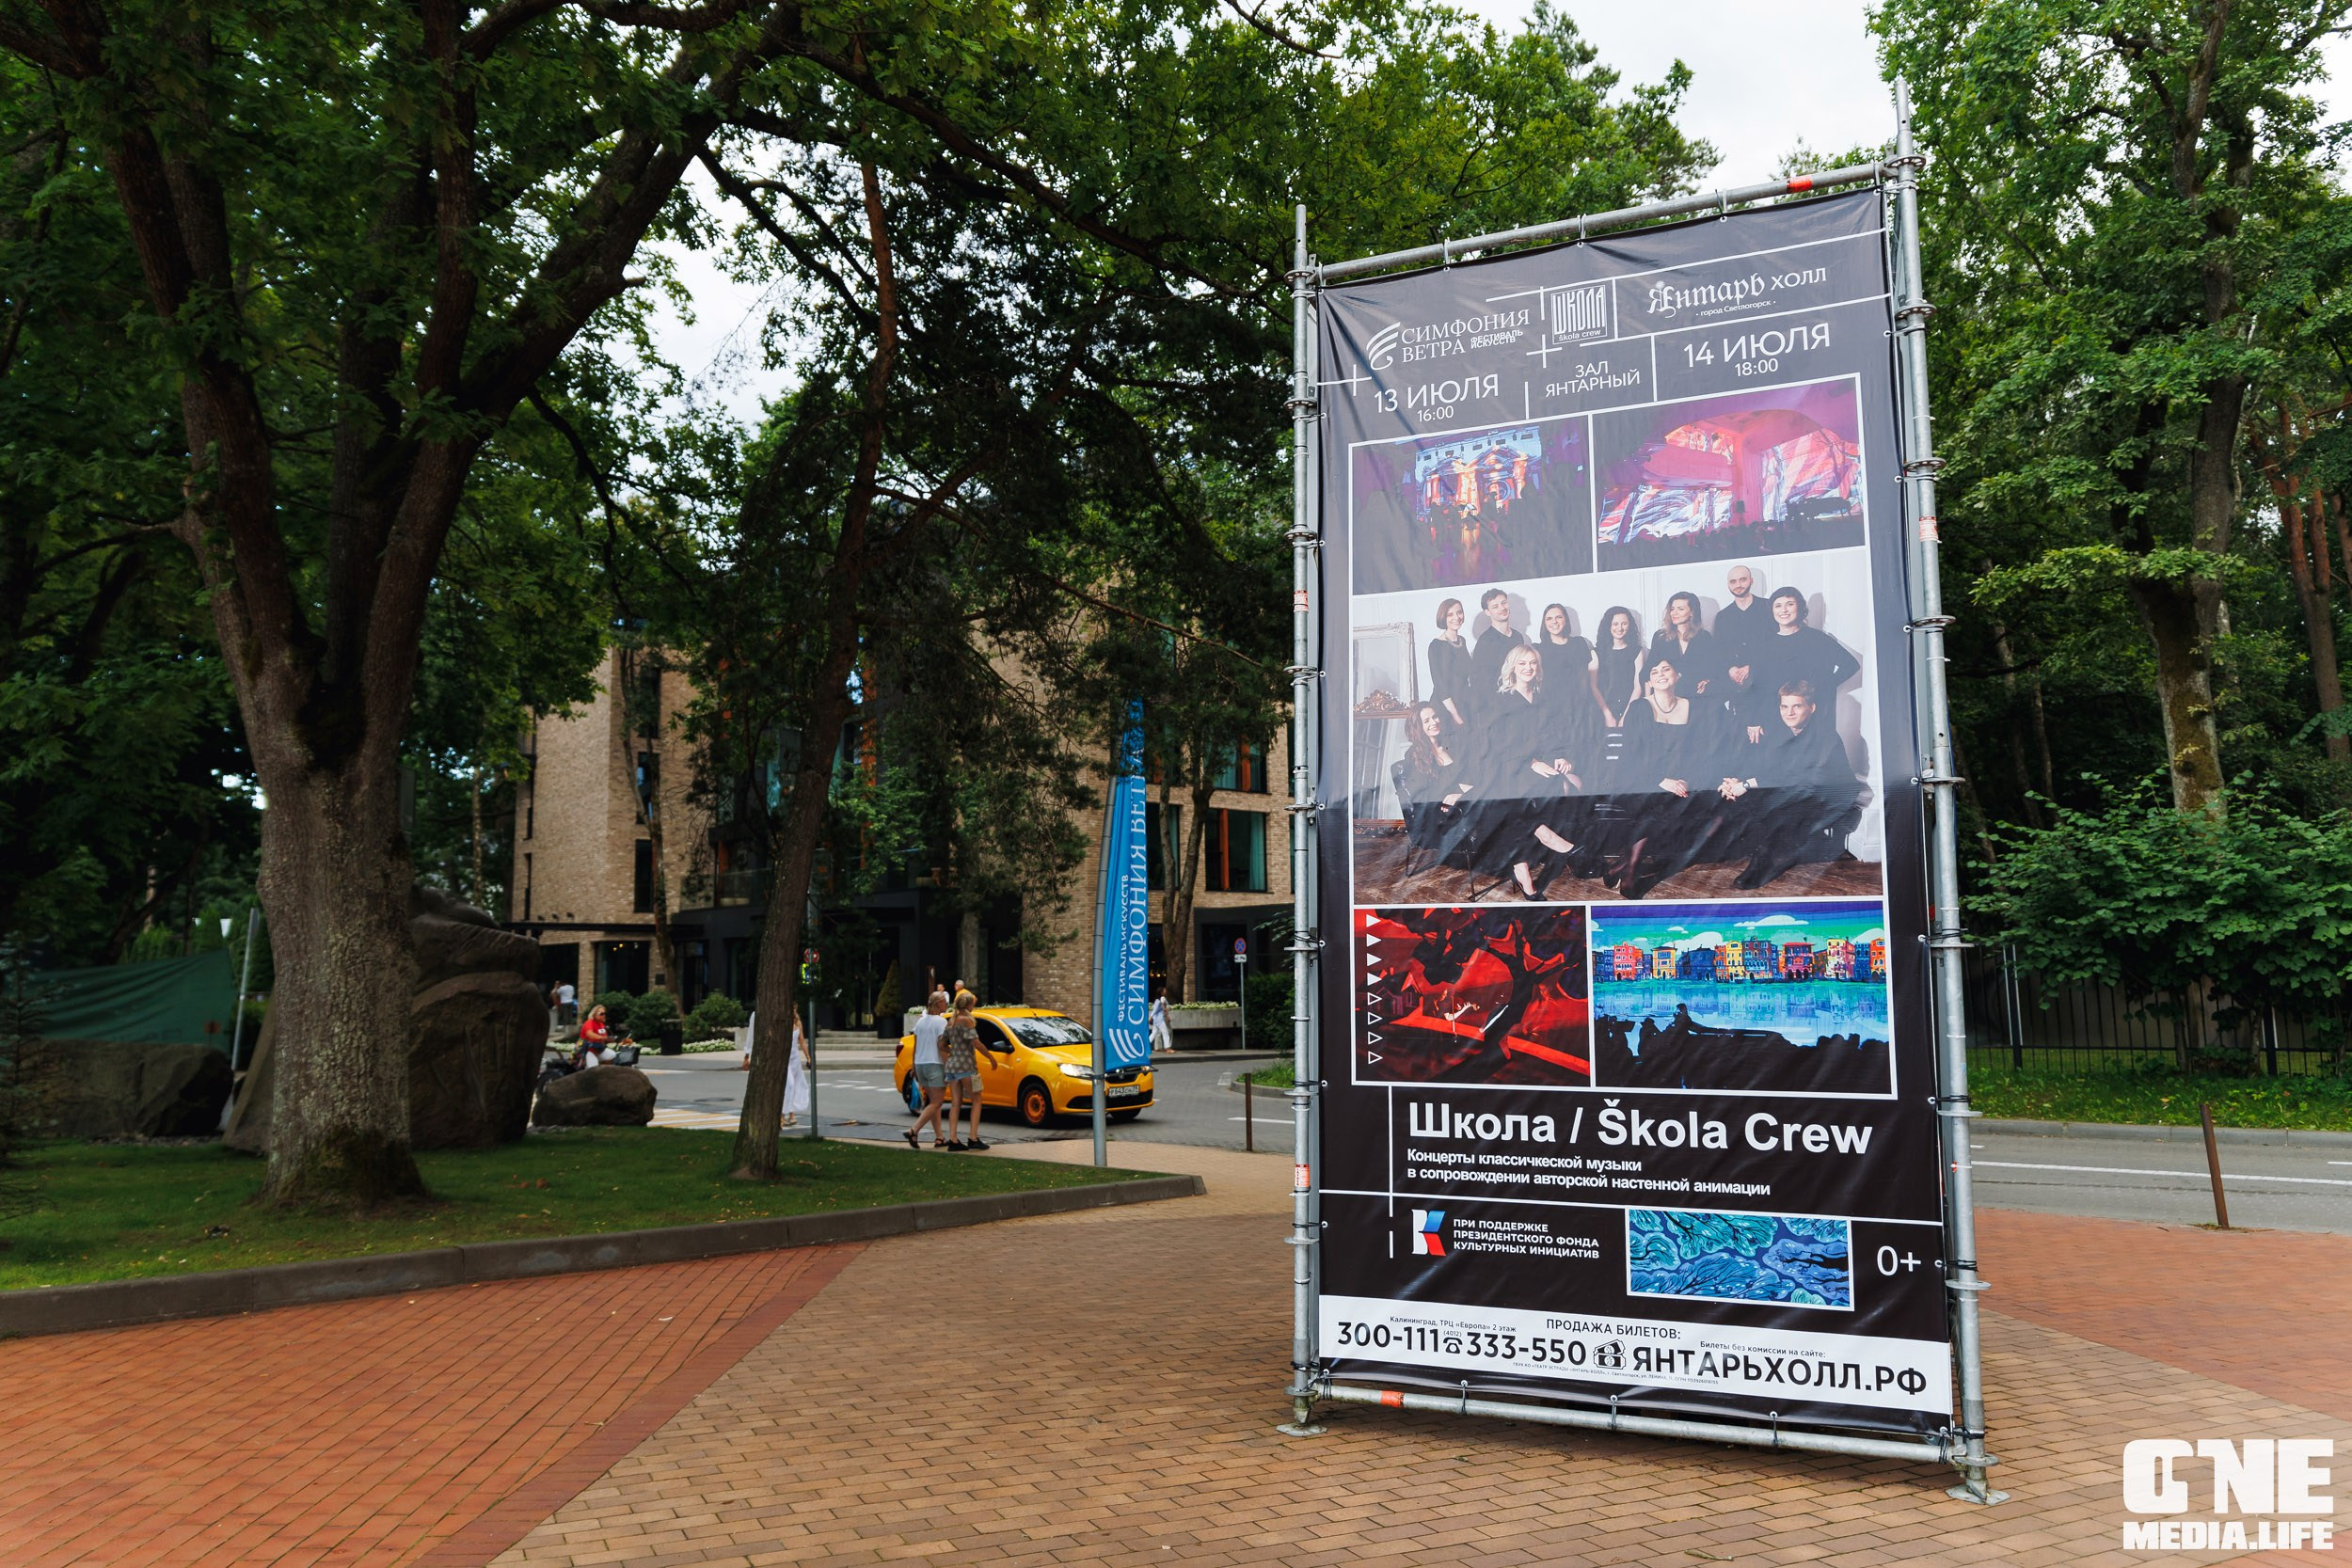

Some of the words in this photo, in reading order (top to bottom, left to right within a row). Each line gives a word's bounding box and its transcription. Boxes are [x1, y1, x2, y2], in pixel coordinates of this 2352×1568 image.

[1646, 273, 1765, 319] Янтарь
[1700, 308, 1723, 316] город
[1724, 301, 1772, 312] Светлогорск
[1552, 286, 1605, 335] ШКОЛА
[1401, 309, 1531, 344] СИМФОНИЯ
[1470, 329, 1524, 343] ФЕСТИВАЛЬ
[1581, 329, 1601, 338] crew
[1402, 339, 1466, 363] ВЕТРА
[1470, 336, 1516, 349] ИСКУССТВ
[1683, 341, 1714, 368] 14
[1723, 322, 1831, 362] ИЮЛЯ
[1575, 360, 1609, 378] ЗАЛ
[1734, 357, 1779, 376] 18:00
[1374, 388, 1399, 413] 13
[1407, 373, 1500, 409] ИЮЛЯ
[1545, 368, 1641, 398] ЯНТАРНЫЙ
[1417, 405, 1454, 422] 16:00
[1120, 874, 1129, 941] ИСКУССТВ
[1128, 843, 1147, 1026] СИМФОНИЯ
[1117, 942, 1127, 1022] ФЕСТИВАЛЬ
[1409, 1100, 1556, 1144] Школа
[1569, 1107, 1583, 1144] /
[1597, 1098, 1728, 1150] Škola
[1743, 1110, 1874, 1155] Crew
[1407, 1148, 1475, 1164] Концерты
[1586, 1159, 1642, 1173] музыки
[1407, 1167, 1417, 1178] в
[1420, 1168, 1530, 1183] сопровождении
[1534, 1173, 1608, 1189] авторской
[1612, 1177, 1690, 1192] настенной
[1693, 1180, 1771, 1196] анимации
[1453, 1219, 1475, 1228] ПРИ
[1479, 1220, 1549, 1233] ПОДДЕРЖКЕ
[1454, 1229, 1553, 1244] ПРЕЗИДЕНТСКОГО
[1556, 1236, 1599, 1248] ФОНДА
[1454, 1241, 1527, 1254] КУЛЬТУРНЫХ
[1530, 1246, 1599, 1259] ИНИЦИАТИВ
[1876, 1245, 1922, 1276] 0+
[1390, 1316, 1438, 1326] Калининград,
[1440, 1320, 1454, 1328] ТРЦ
[1455, 1322, 1490, 1331] «Европа»
[1546, 1319, 1613, 1336] ПРОДАЖА
[1616, 1324, 1681, 1340] БИЛЕТОВ:
[1338, 1322, 1439, 1353] 300-111
[1466, 1332, 1587, 1366] 333-550
[1700, 1340, 1730, 1350] Билеты
[1732, 1343, 1746, 1352] без
[1747, 1346, 1787, 1355] комиссии
[1801, 1349, 1826, 1358] сайте:
[1632, 1346, 1927, 1396] ЯНТАРЬХОЛЛ.РФ
